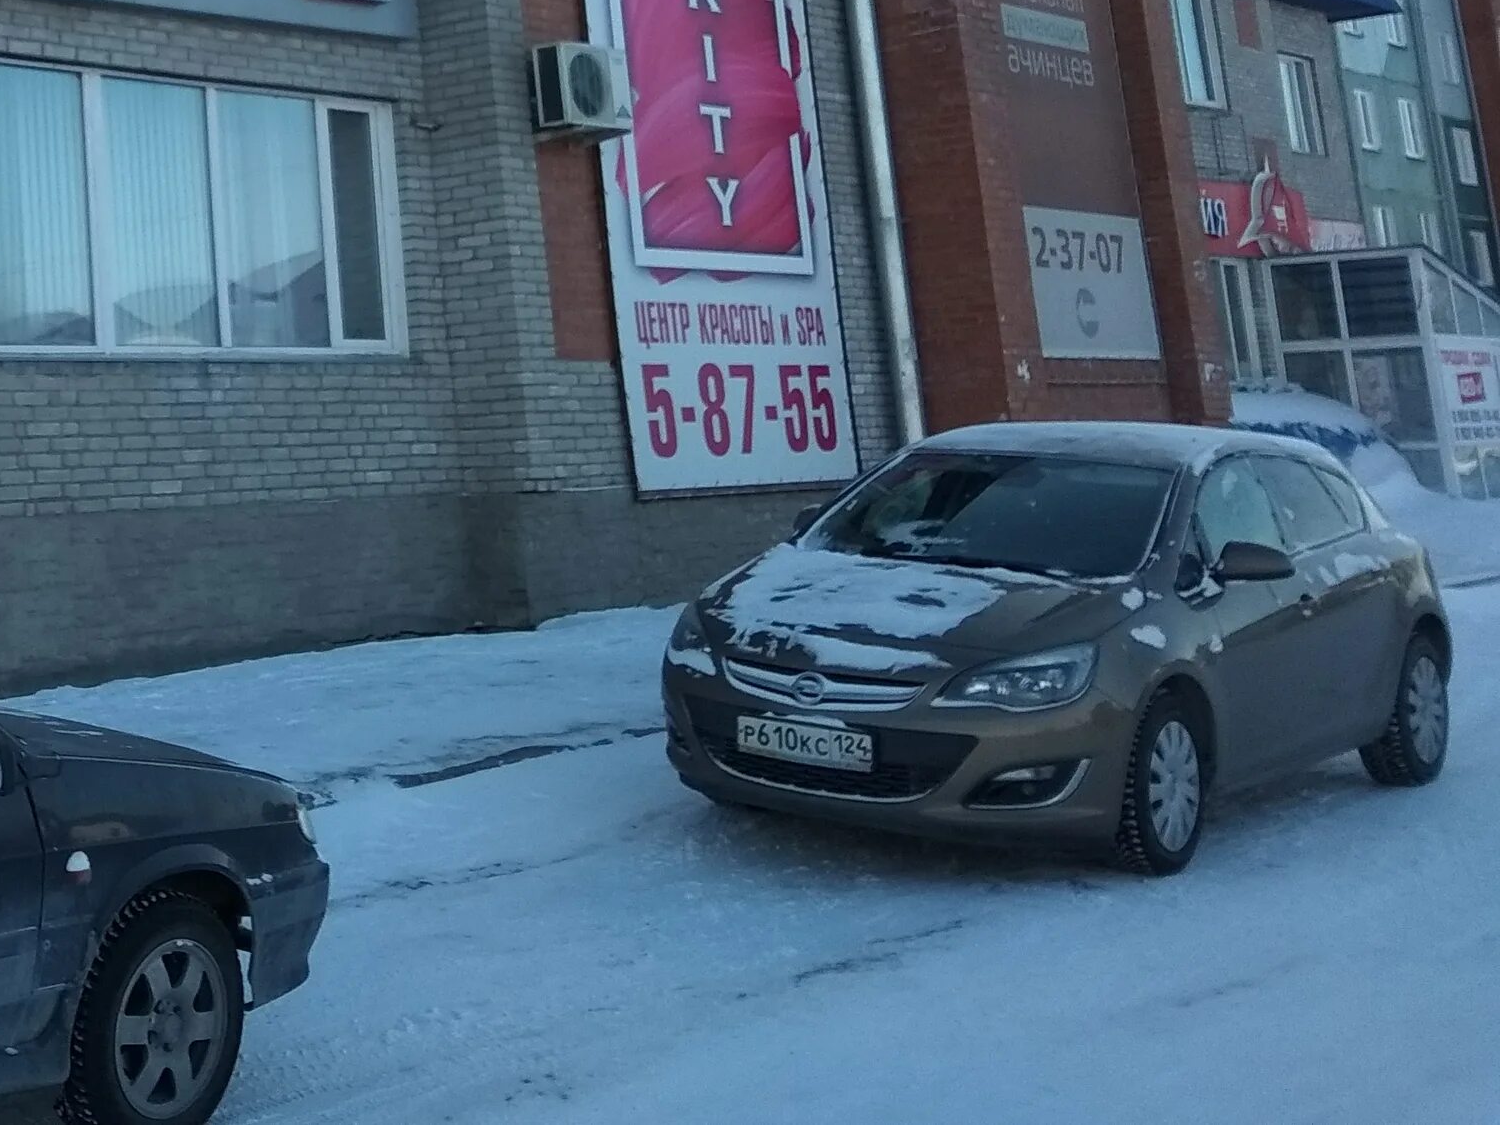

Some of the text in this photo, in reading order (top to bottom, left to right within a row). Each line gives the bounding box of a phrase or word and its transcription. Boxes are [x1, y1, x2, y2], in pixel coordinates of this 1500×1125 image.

[1031, 226, 1124, 274] 2-37-07
[634, 301, 690, 349] ЦЕНТР
[697, 303, 775, 345] КРАСОТЫ
[795, 306, 827, 346] SPA
[641, 362, 838, 458] 5-87-55
